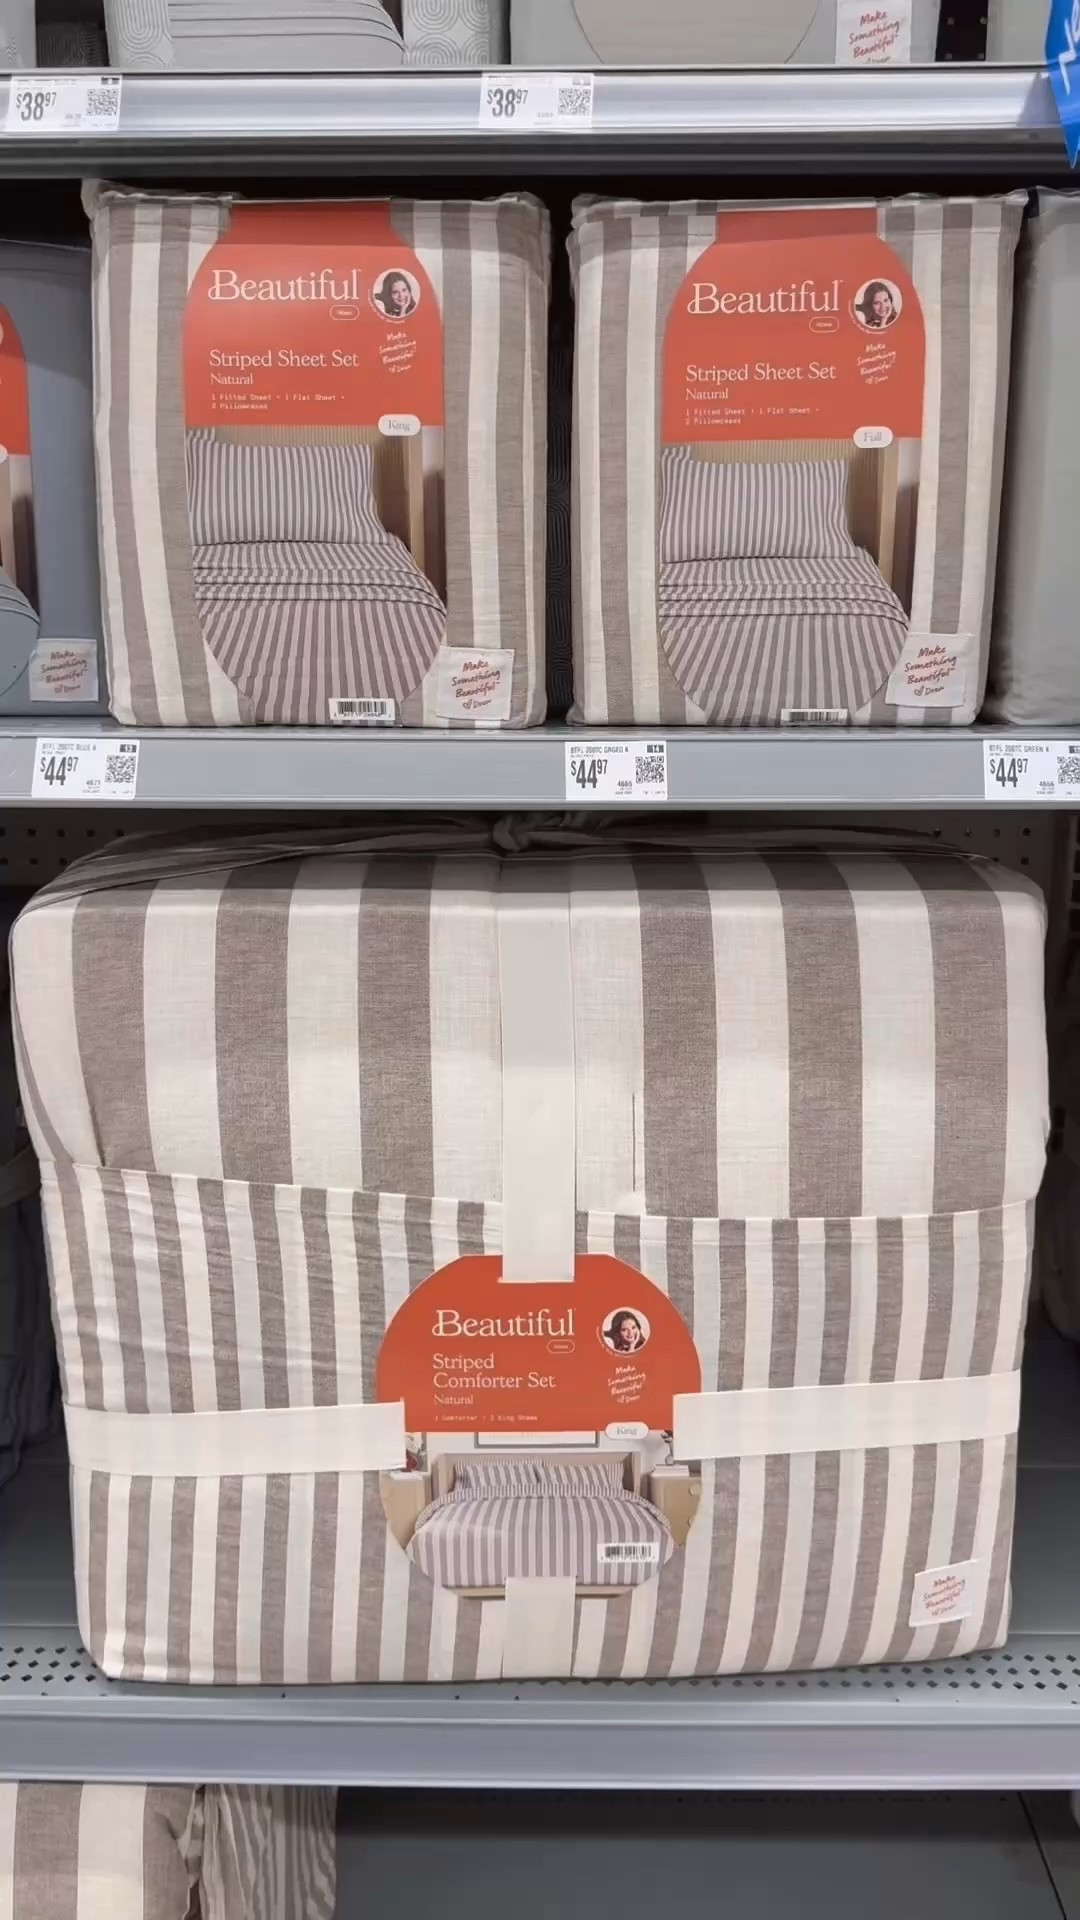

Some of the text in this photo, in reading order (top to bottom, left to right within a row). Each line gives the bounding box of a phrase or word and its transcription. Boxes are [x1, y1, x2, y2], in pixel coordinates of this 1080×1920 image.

[860, 11, 887, 26] Make
[849, 21, 900, 45] Something
[853, 34, 895, 58] Beautiful
[208, 268, 359, 301] Beautiful
[687, 279, 839, 314] Beautiful
[865, 343, 886, 353] Make
[209, 349, 360, 370] Striped Sheet Set
[210, 373, 254, 385] Natural
[686, 361, 837, 386] Striped Sheet Set
[685, 388, 729, 400] Natural
[388, 419, 410, 432] King
[864, 431, 882, 442] Full
[50, 651, 74, 661] Make
[917, 645, 946, 658] Make
[41, 658, 88, 673] Something
[462, 659, 489, 672] Make
[904, 655, 957, 673] Something
[451, 670, 500, 687] Something
[907, 668, 951, 684] Beautiful
[456, 683, 496, 698] Beautiful
[925, 686, 944, 696] Drew
[432, 1308, 575, 1337] Beautiful
[432, 1352, 495, 1373] Striped
[616, 1364, 636, 1375] Make
[433, 1371, 556, 1388] Comforter Set
[607, 1372, 647, 1387] Something
[433, 1394, 474, 1405] Natural
[617, 1426, 637, 1437] King
